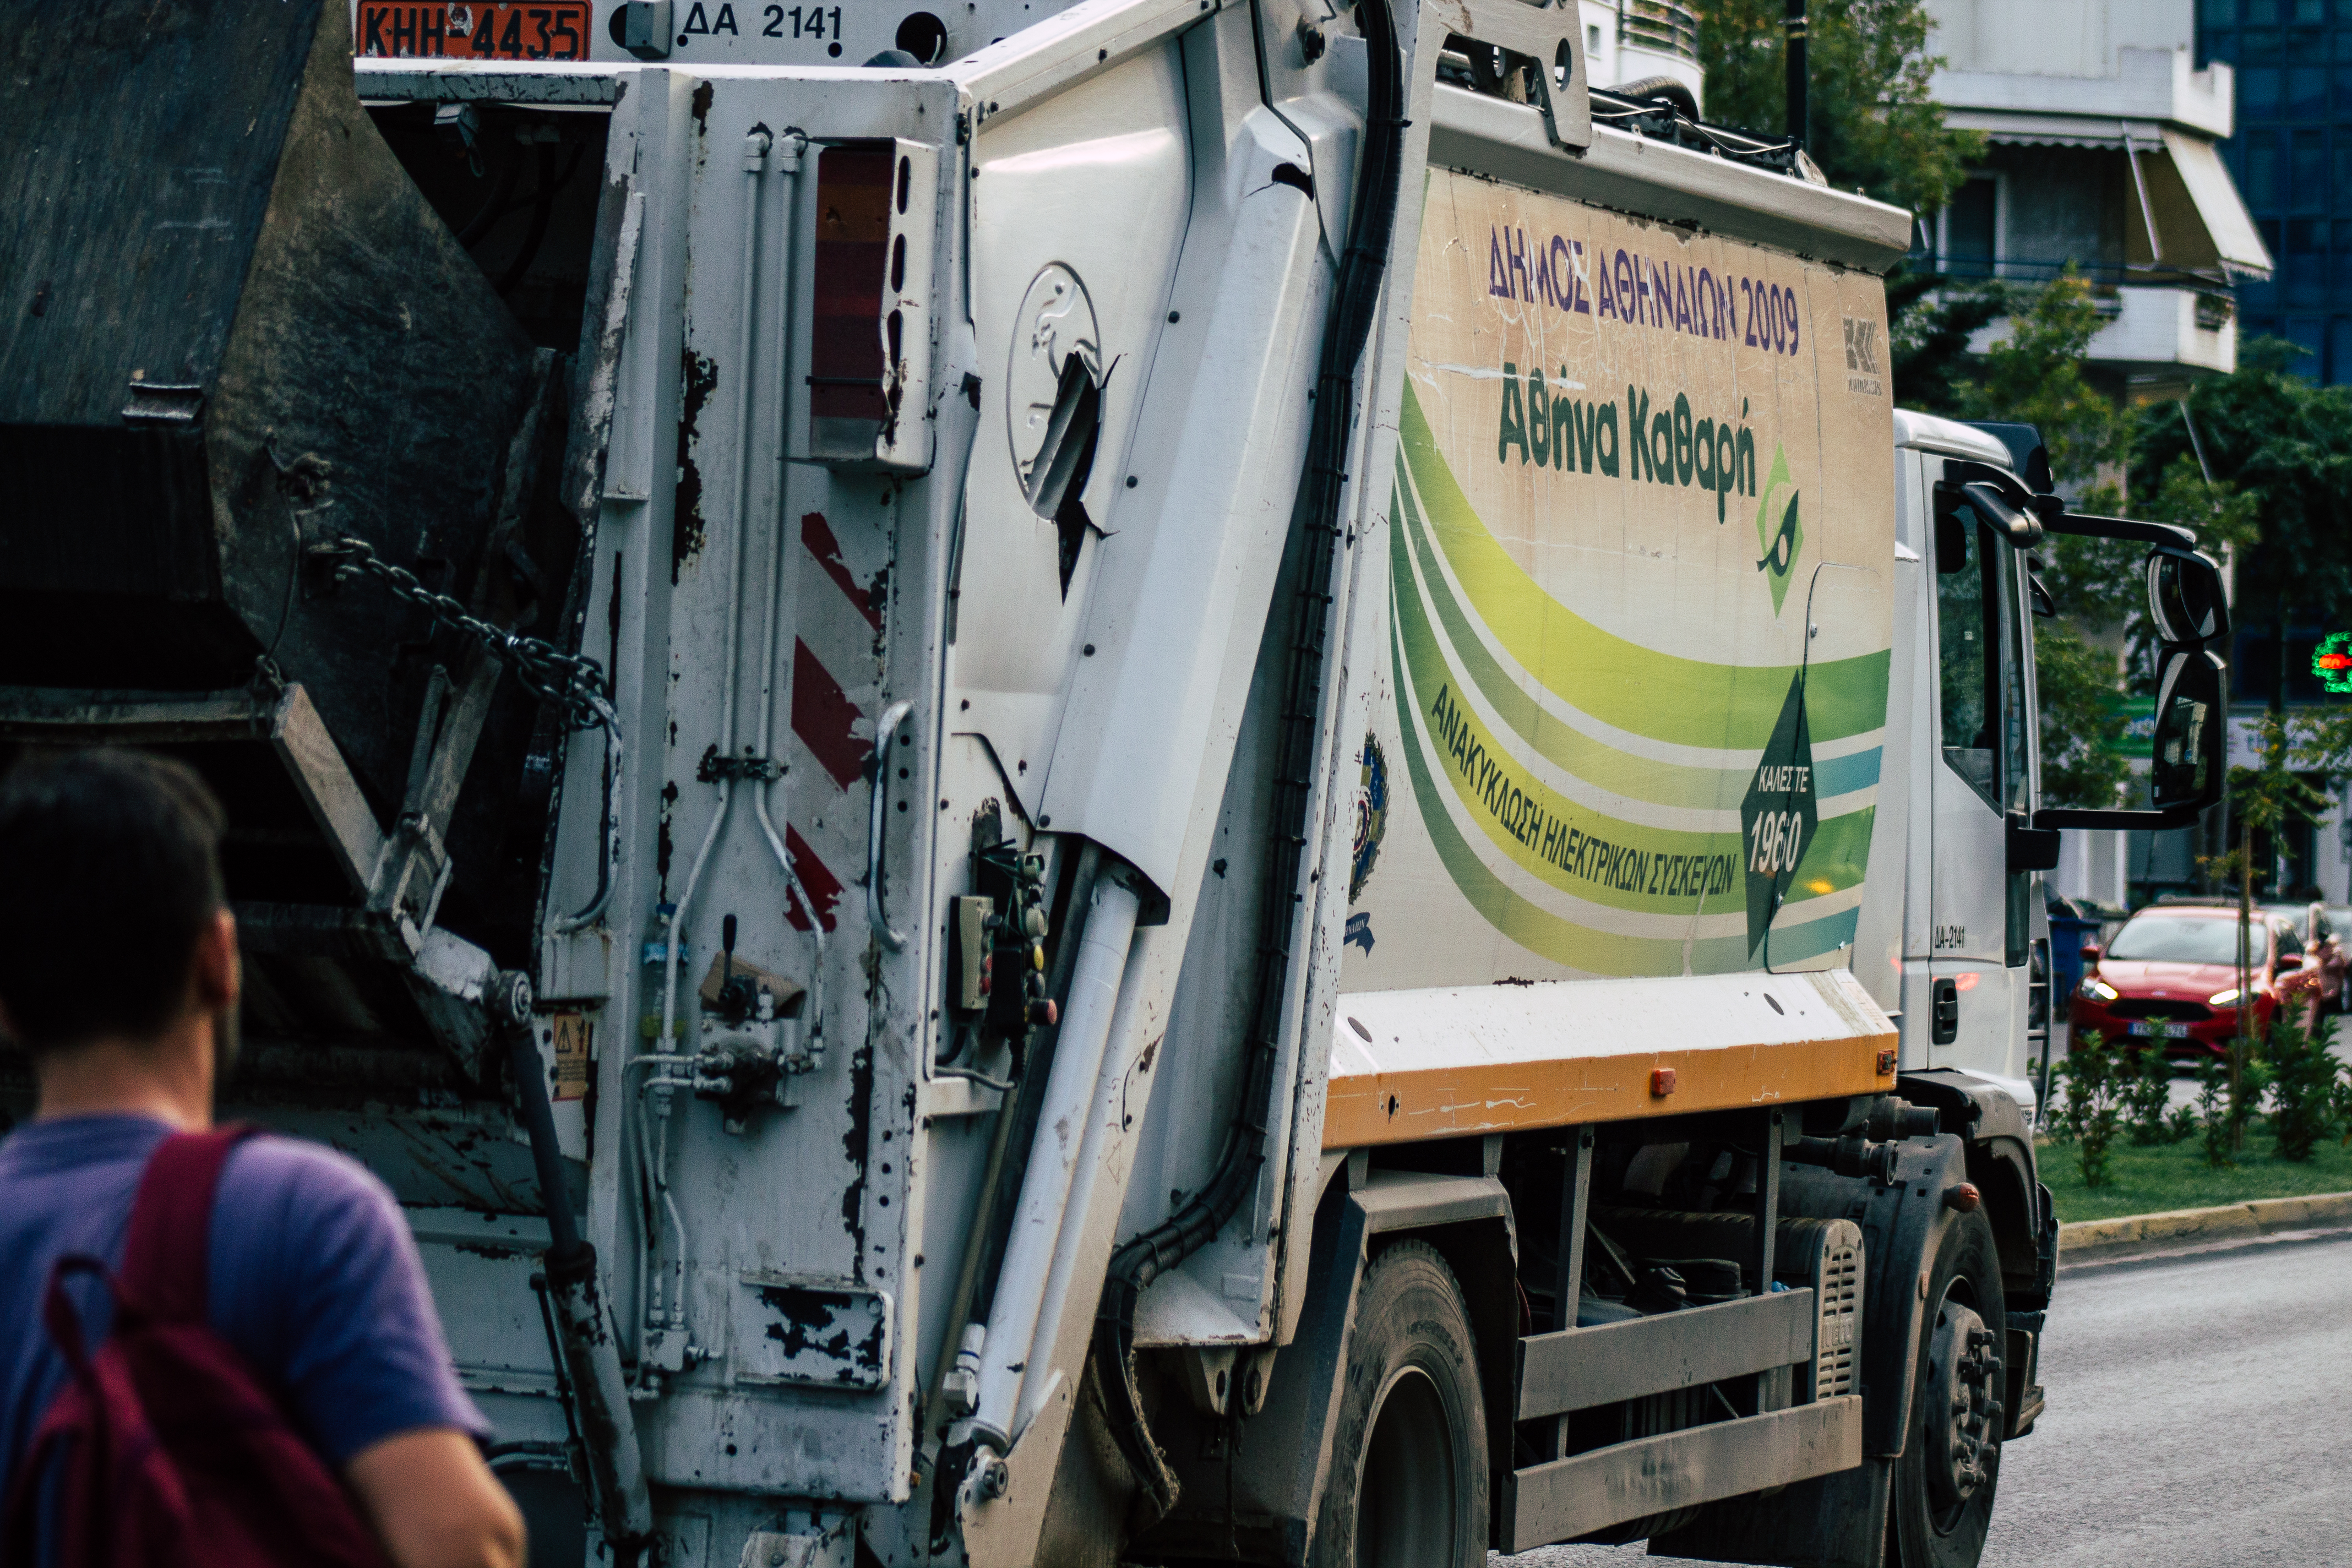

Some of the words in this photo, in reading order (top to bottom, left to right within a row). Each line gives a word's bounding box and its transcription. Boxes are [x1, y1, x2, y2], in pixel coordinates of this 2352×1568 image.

[683, 2, 739, 36] ΔΑ
[762, 4, 841, 40] 2141
[1489, 225, 1589, 314] ΔΗΜΟΣ
[1599, 248, 1738, 342] ΑΘΗΝΑΙΩΝ
[1740, 276, 1799, 357] 2009
[1498, 361, 1620, 478] Αθήνα
[1627, 383, 1756, 524] Καθαρή
[1432, 683, 1543, 852] ΑΝΑΚΥΚΛΩΣΗ
[1541, 815, 1650, 893] ΗΛΕΚΤΡΙΚΩΝ
[1650, 853, 1737, 896] ΣΥΣΚΕΥΩΝ
[1758, 765, 1809, 793] ΚΑΛΕΣΤΕ
[1749, 811, 1802, 873] 1960
